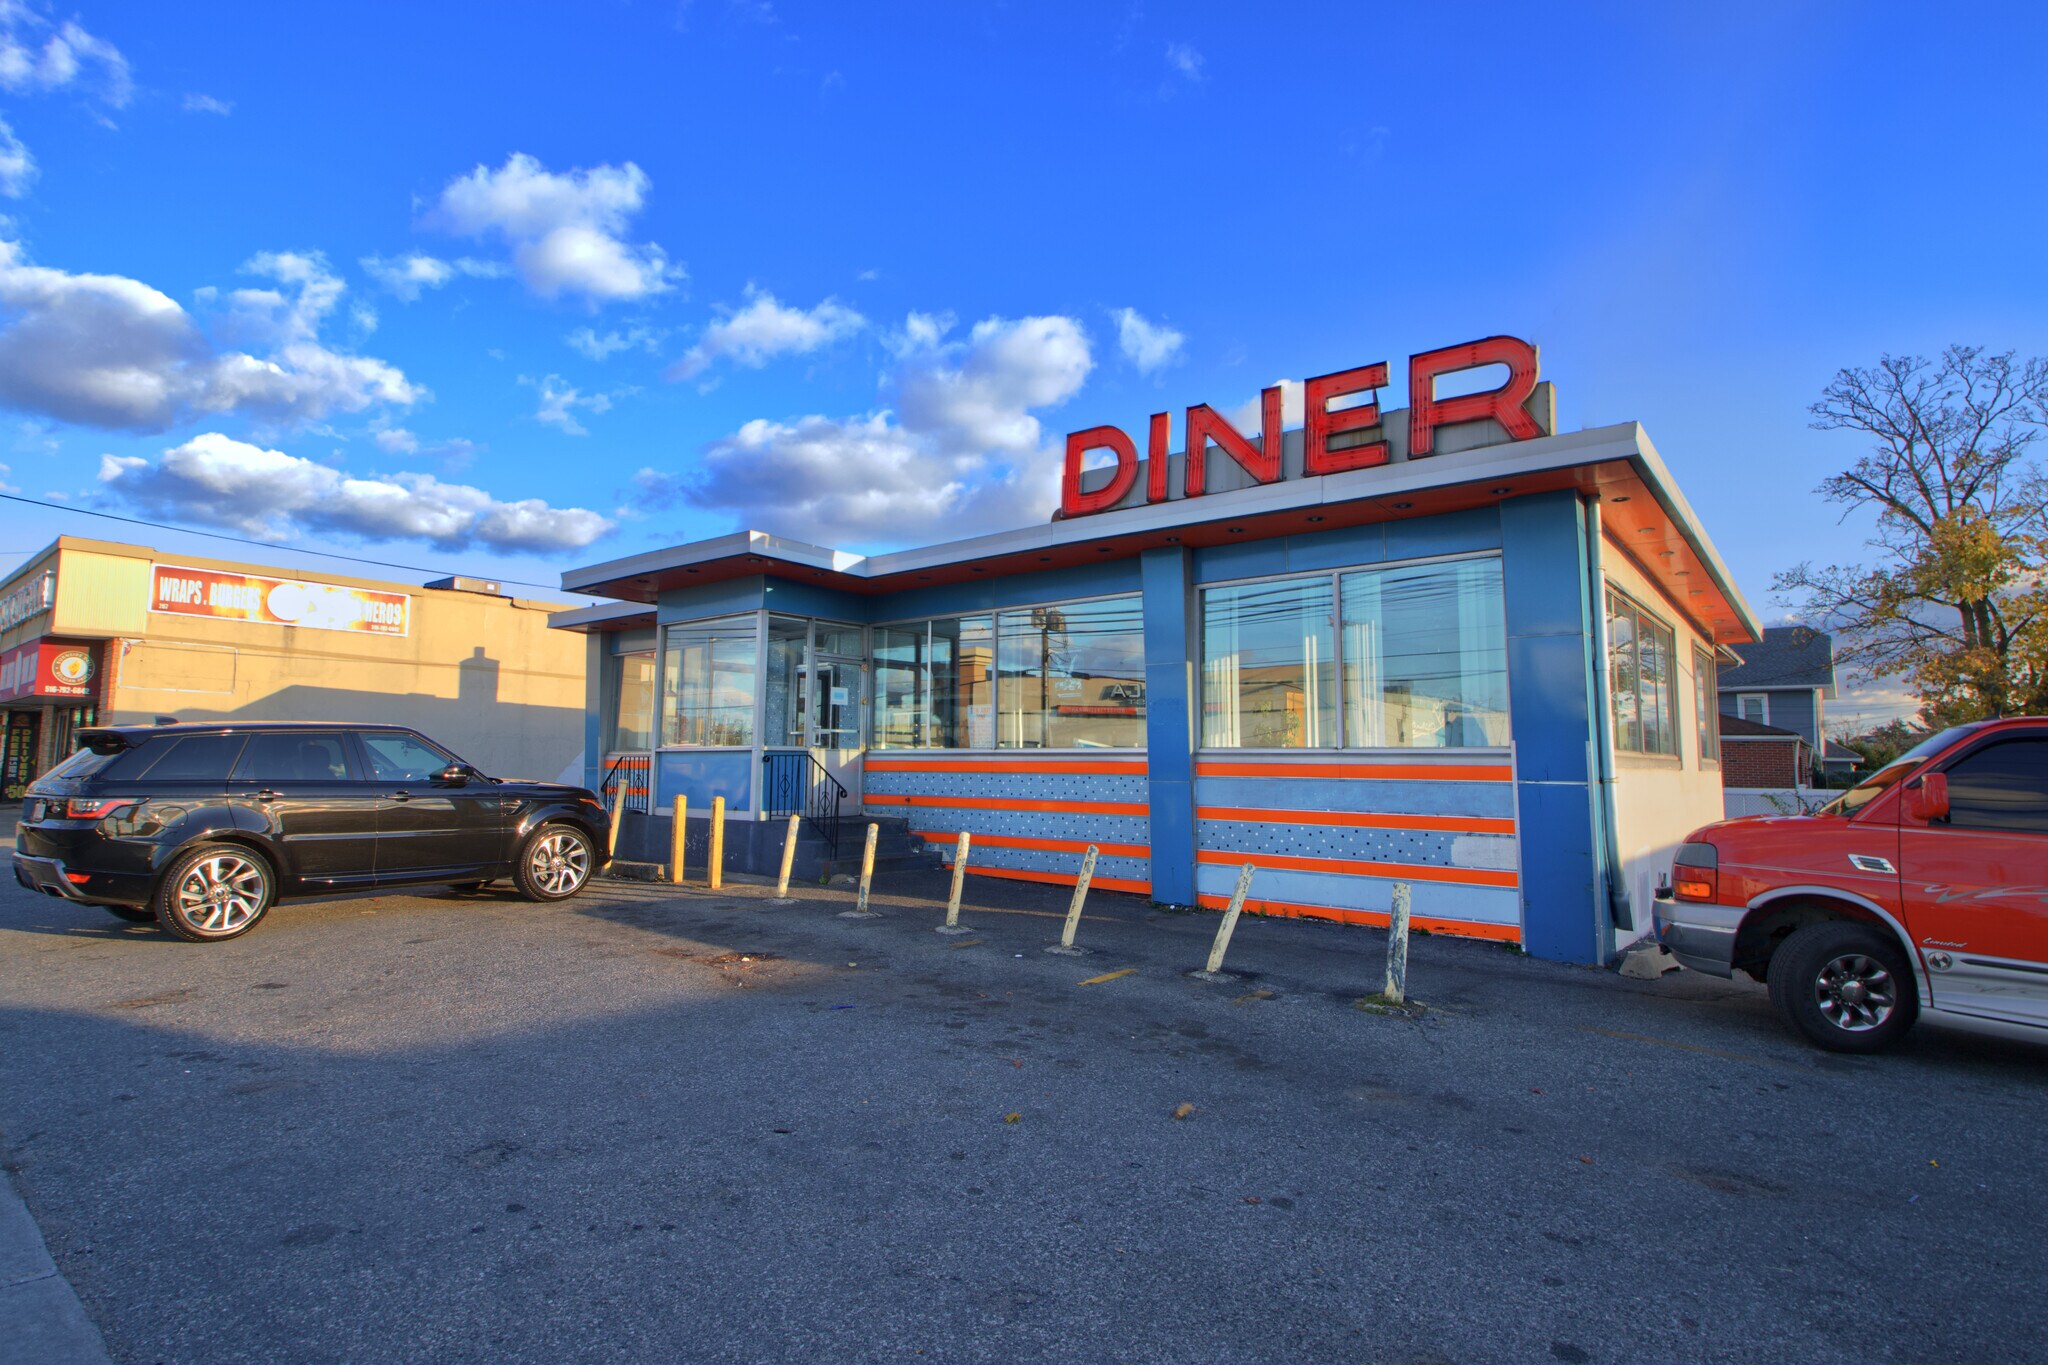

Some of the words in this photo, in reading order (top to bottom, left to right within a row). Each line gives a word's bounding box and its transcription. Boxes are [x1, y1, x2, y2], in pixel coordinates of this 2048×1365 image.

[1062, 334, 1548, 519] DINER
[160, 576, 203, 605] WRAPS
[209, 582, 261, 611] BURGERS
[365, 600, 401, 625] HEROS
